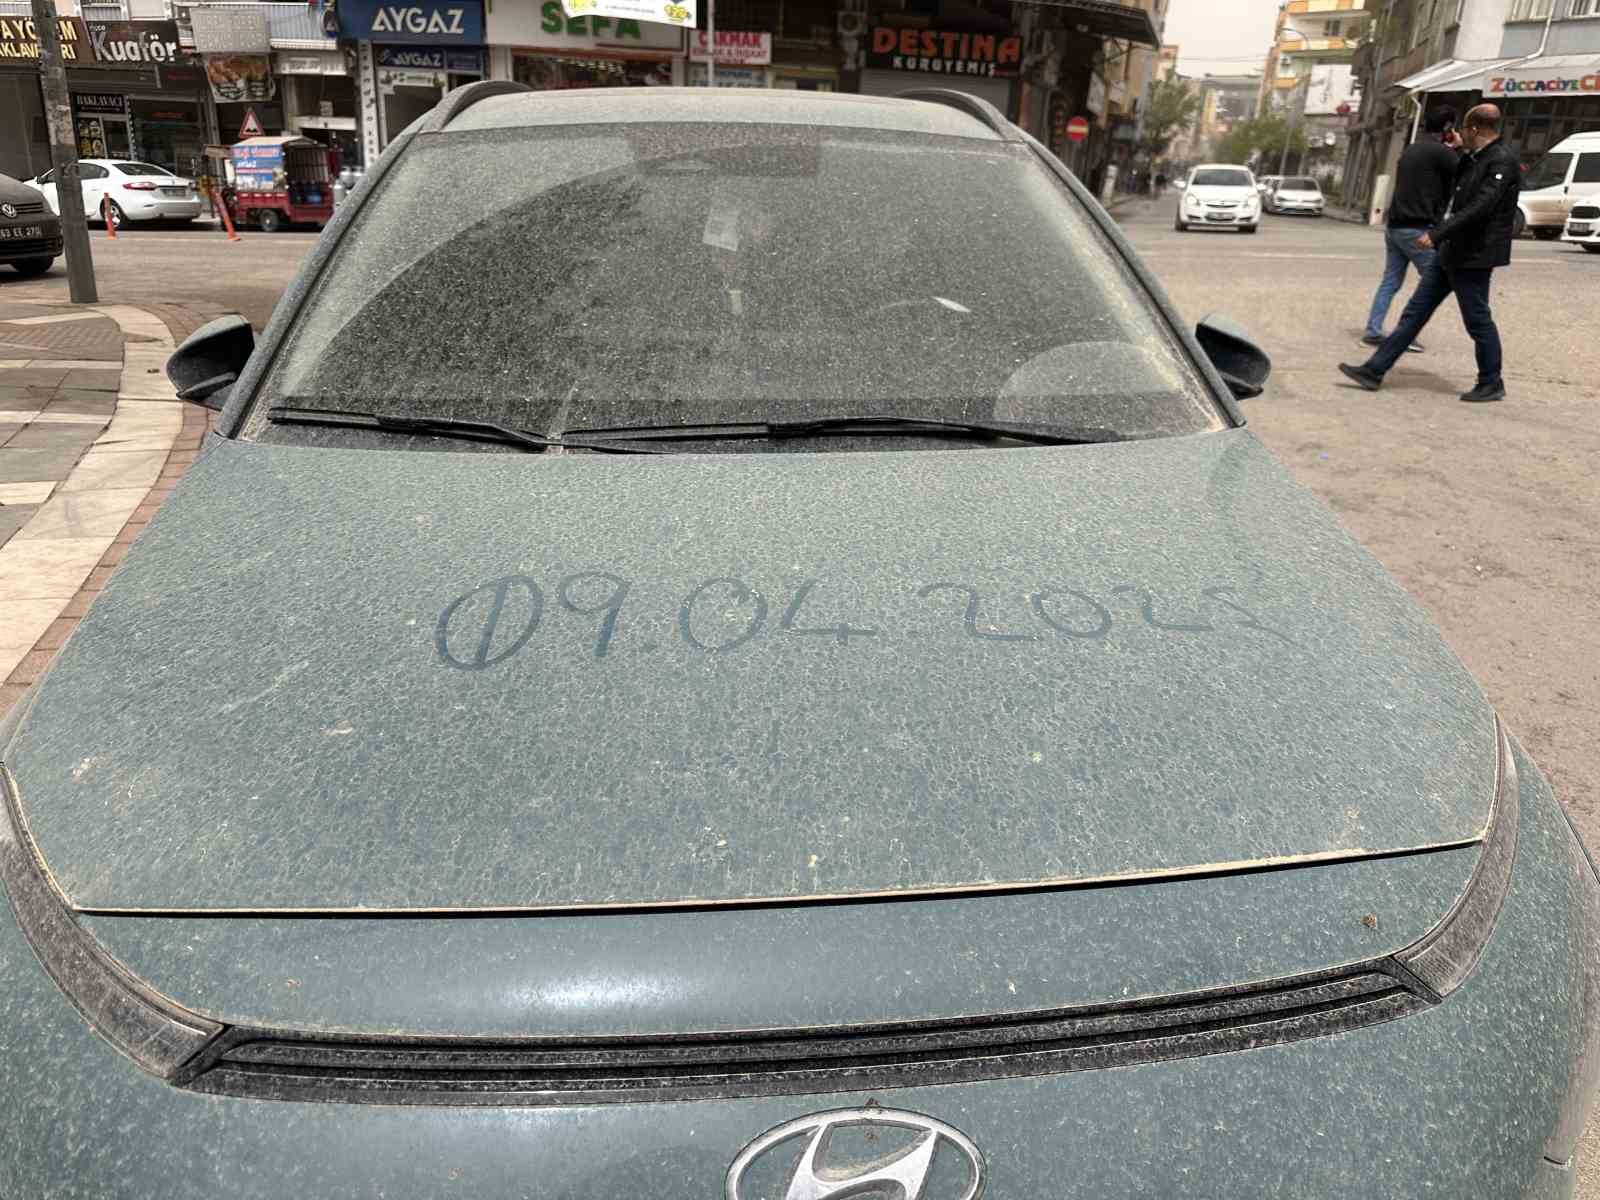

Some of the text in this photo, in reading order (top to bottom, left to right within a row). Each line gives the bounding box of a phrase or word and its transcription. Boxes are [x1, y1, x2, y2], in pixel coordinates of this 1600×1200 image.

[371, 6, 465, 34] AYGAZ
[90, 31, 176, 62] Kuaför
[397, 51, 442, 66] AYGAZ
